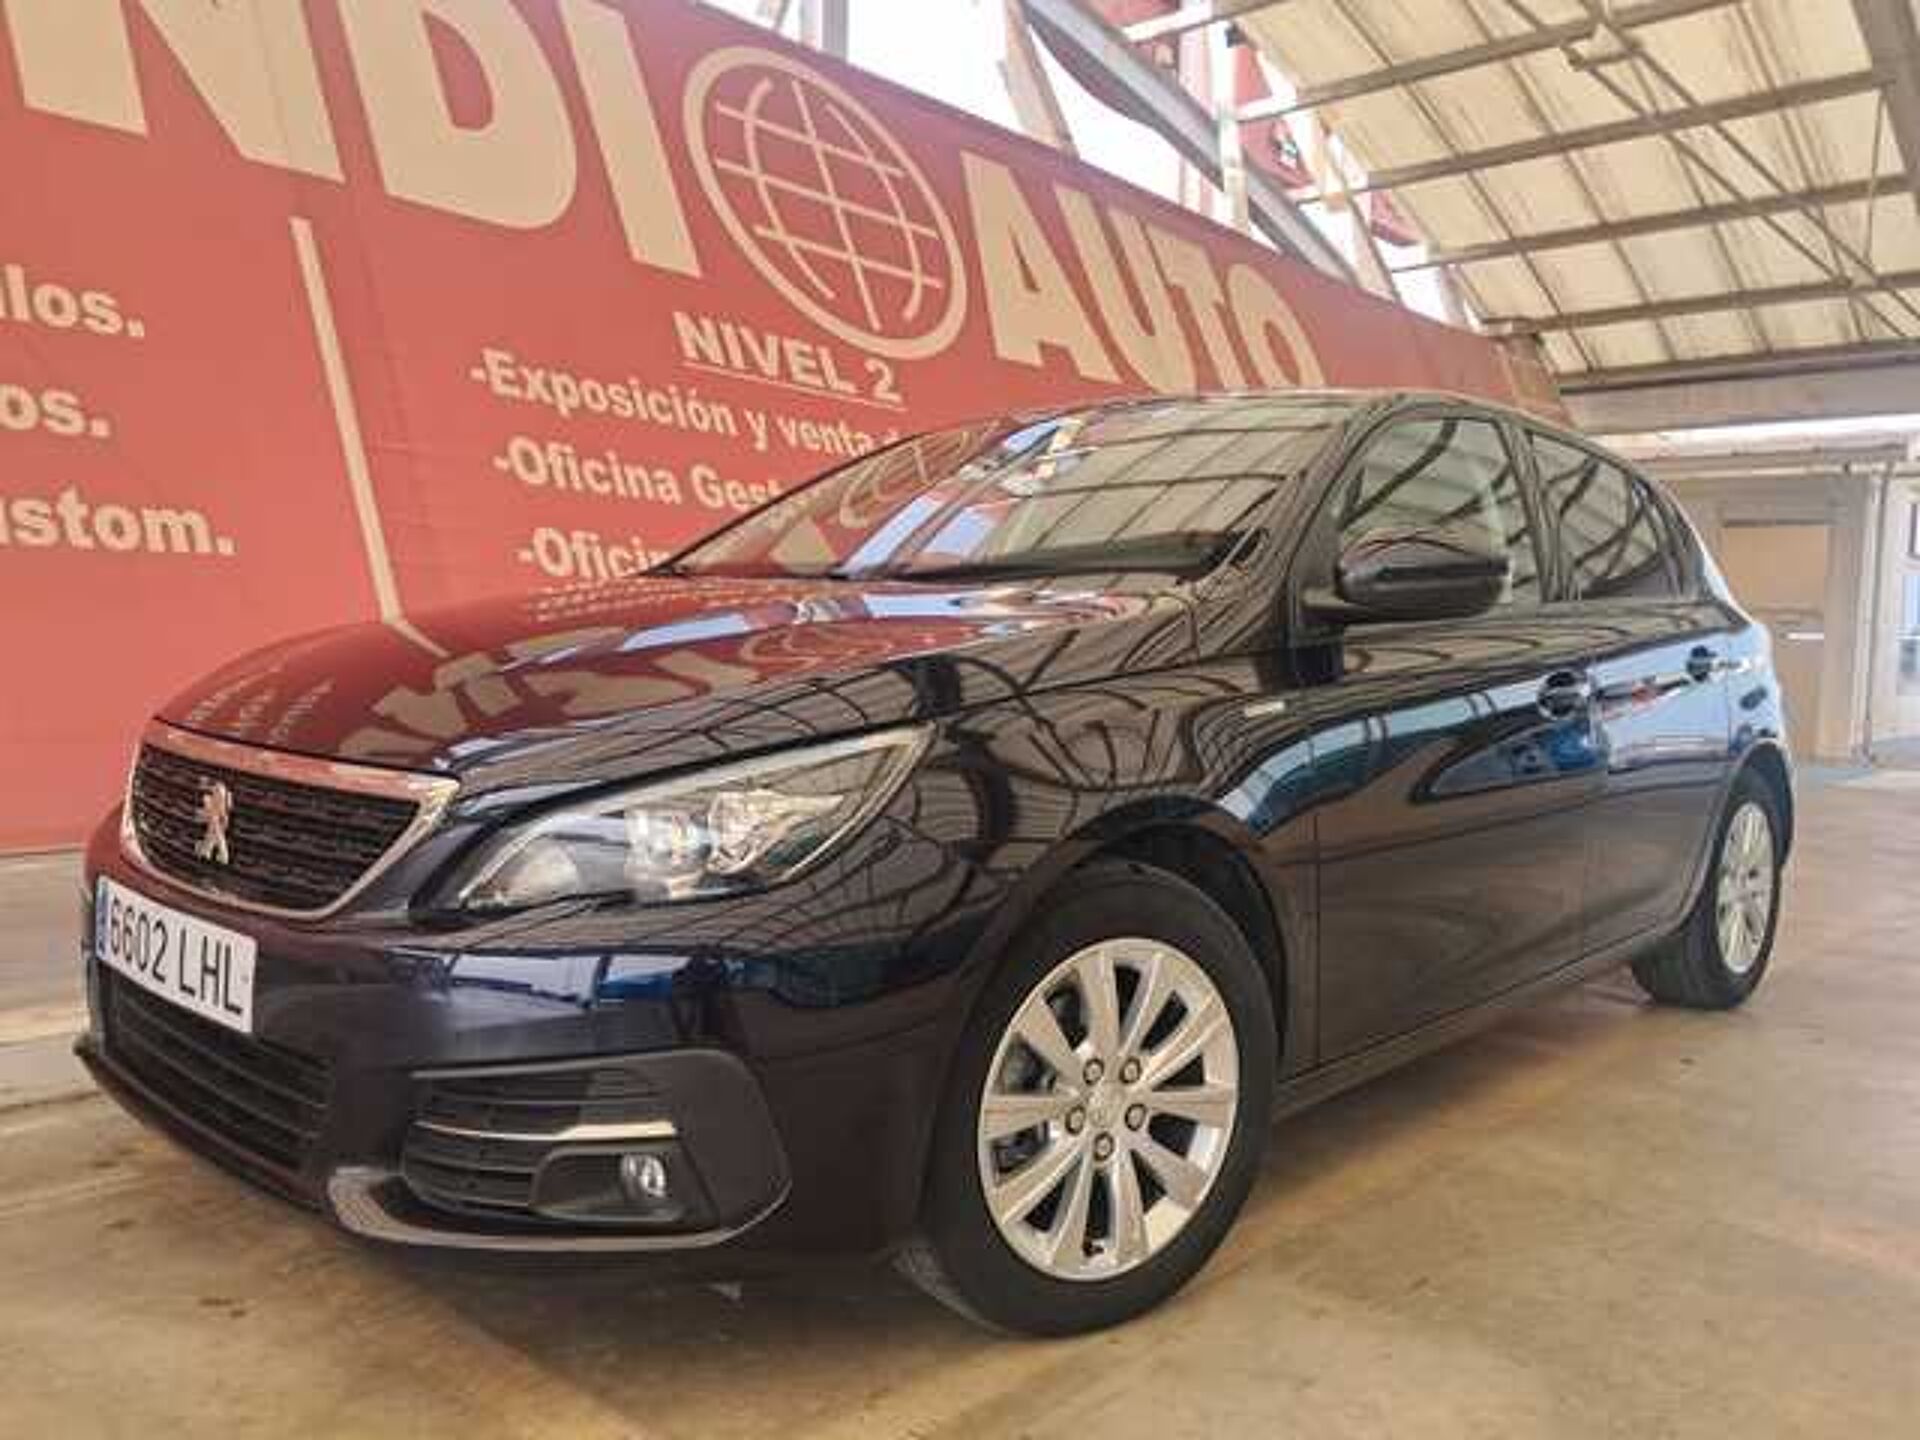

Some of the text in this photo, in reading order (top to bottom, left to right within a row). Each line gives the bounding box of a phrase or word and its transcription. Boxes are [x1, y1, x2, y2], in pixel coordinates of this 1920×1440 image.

[0, 263, 145, 338] los.
[959, 148, 1326, 399] AUTO
[673, 311, 902, 402] NIVEL 2
[470, 348, 738, 436] -Exposición
[744, 407, 768, 452] y
[777, 416, 873, 457] venta
[494, 435, 681, 505] -Oficina
[0, 487, 237, 556] stom.
[111, 896, 243, 1016] 6602 LHL
